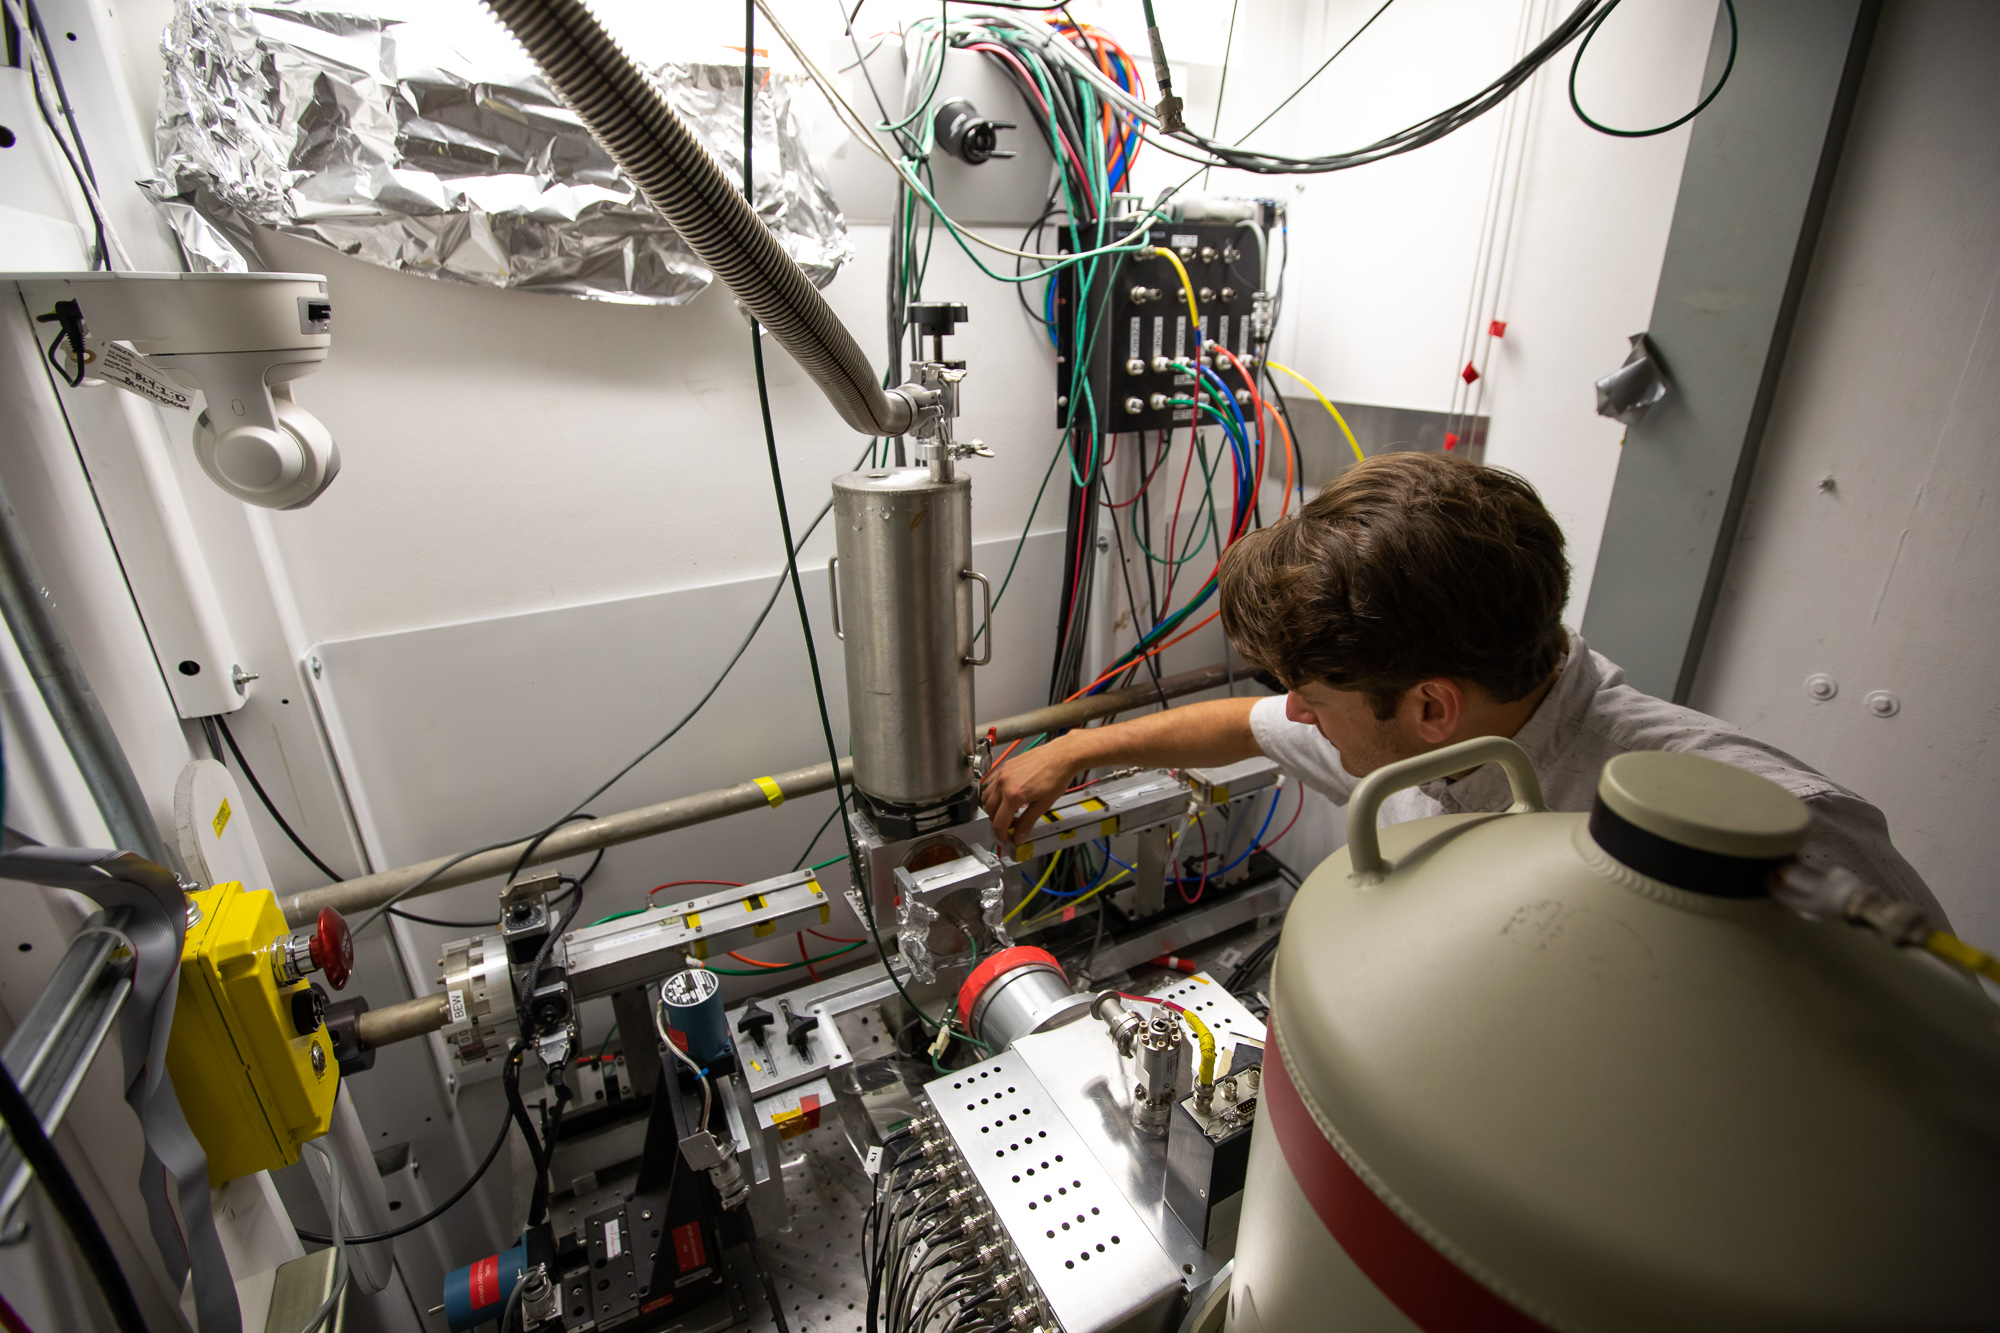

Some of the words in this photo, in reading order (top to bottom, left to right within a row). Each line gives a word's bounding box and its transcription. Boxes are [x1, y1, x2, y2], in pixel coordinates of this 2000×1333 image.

[109, 343, 127, 355] CABLE
[1174, 409, 1202, 419] RETUN
[452, 995, 464, 1018] BEW
